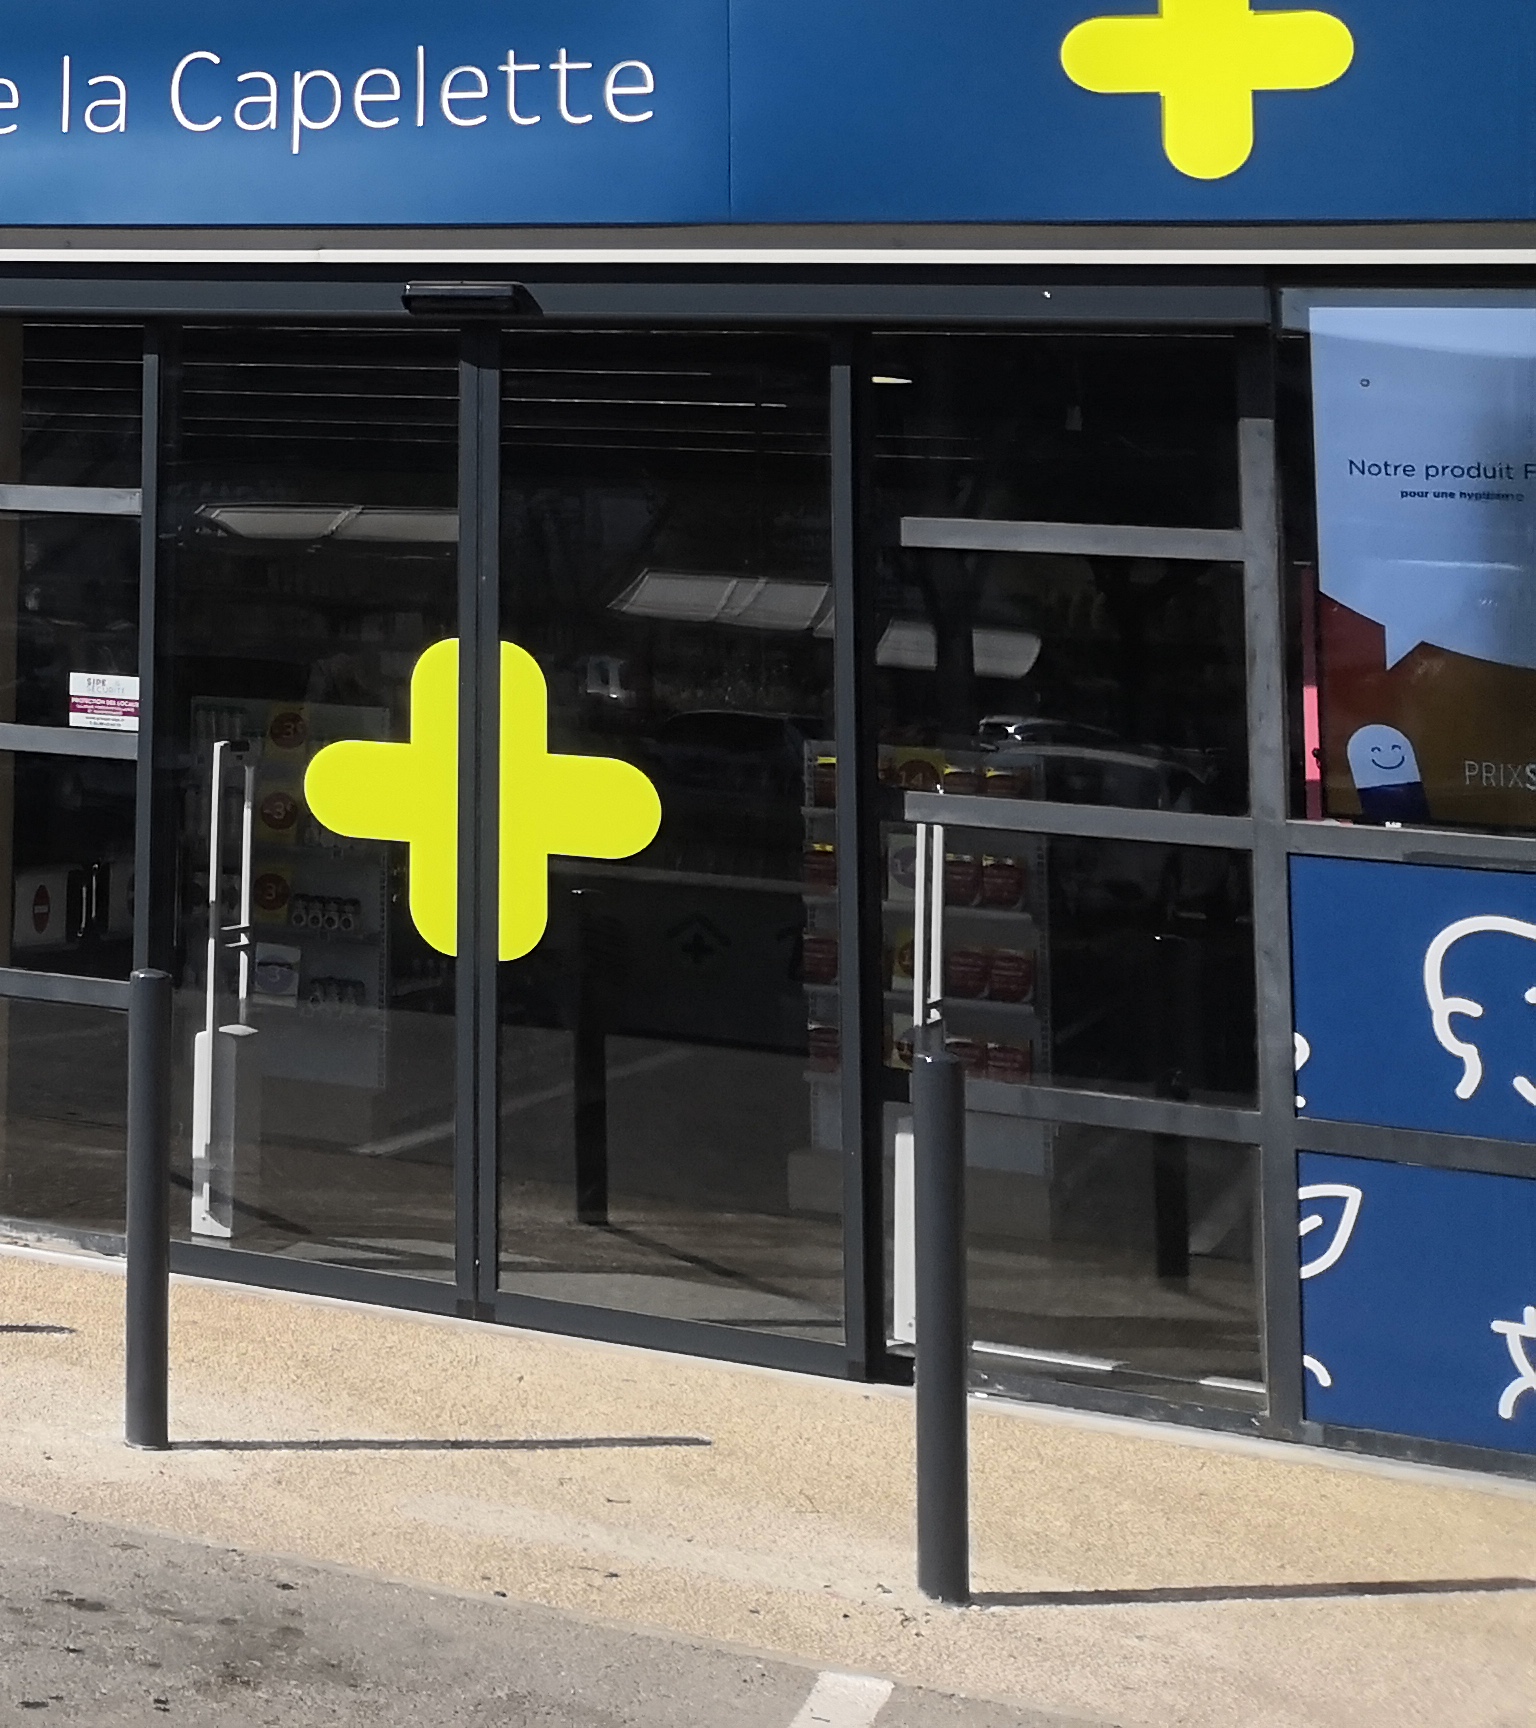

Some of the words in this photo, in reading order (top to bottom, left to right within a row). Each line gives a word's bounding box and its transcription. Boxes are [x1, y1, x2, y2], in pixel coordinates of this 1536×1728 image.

[60, 54, 129, 135] la
[169, 43, 657, 156] Capelette
[1348, 458, 1416, 478] Notre
[1425, 461, 1514, 481] produit
[1400, 489, 1429, 500] pour
[1433, 490, 1456, 499] une
